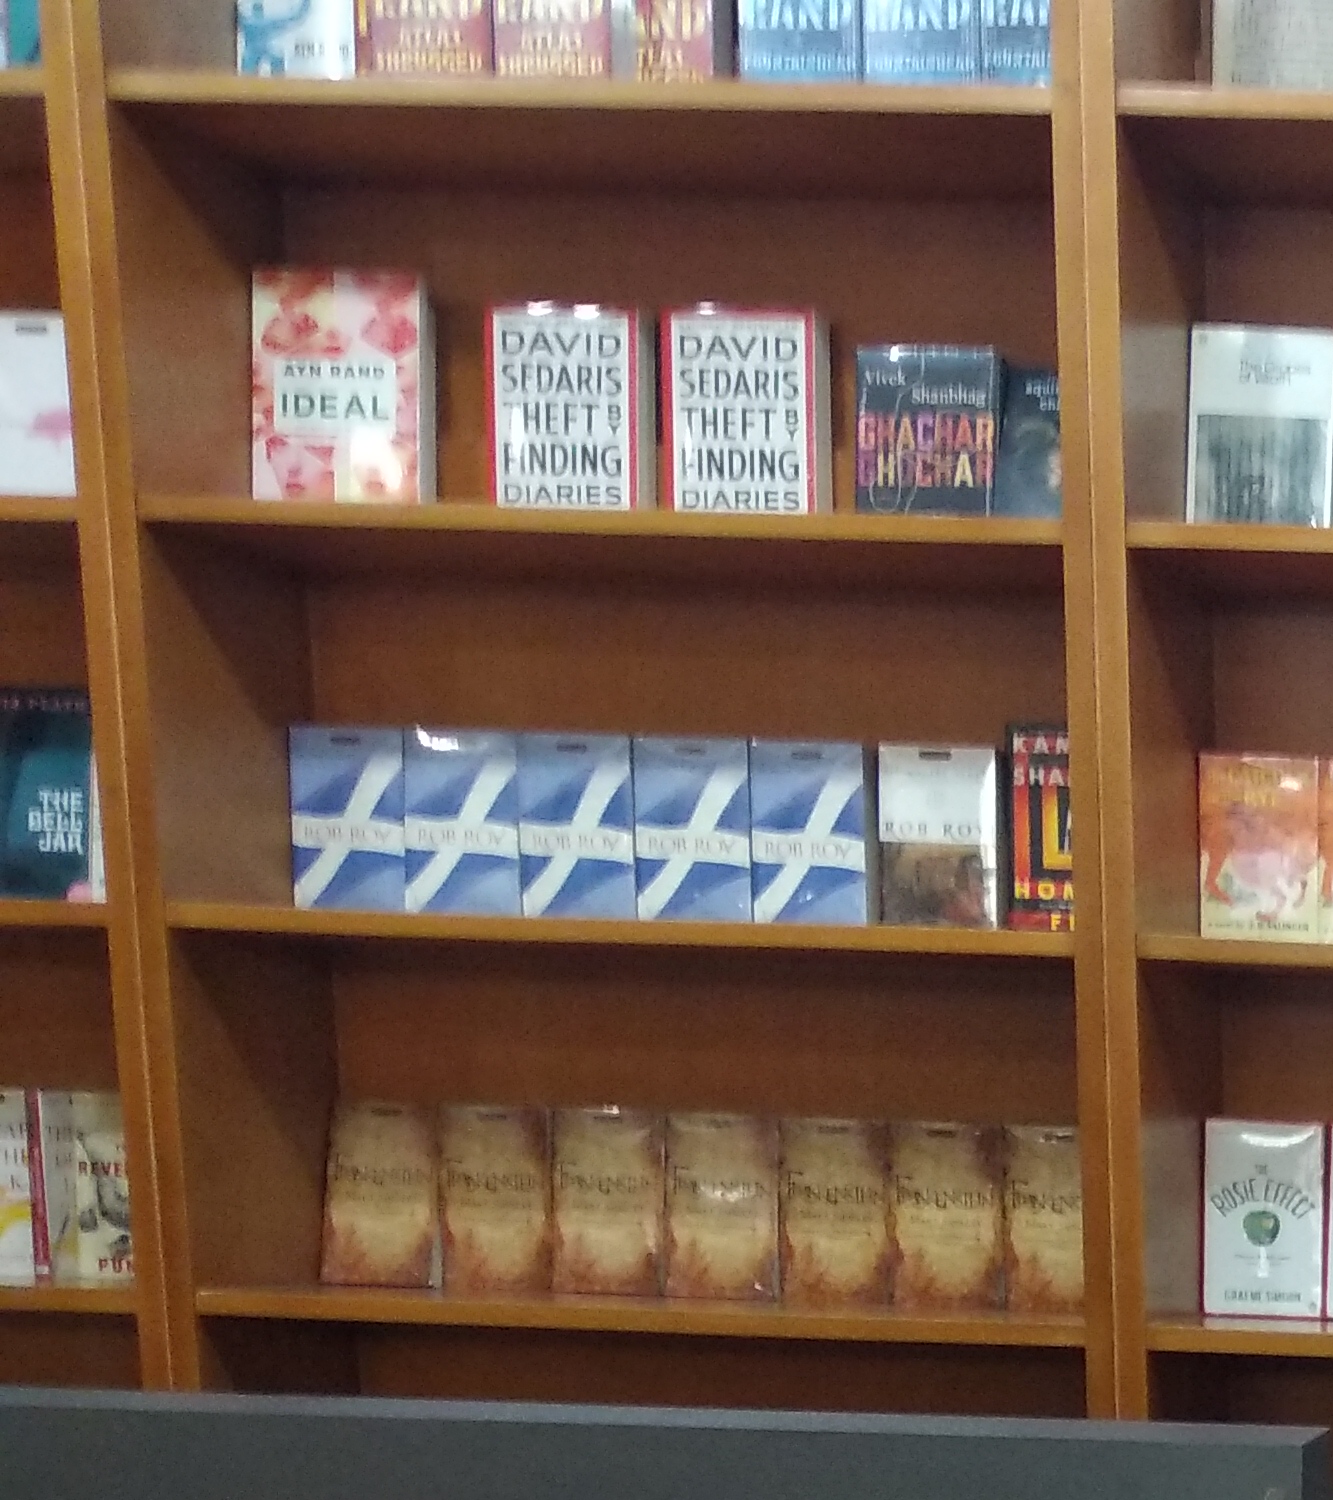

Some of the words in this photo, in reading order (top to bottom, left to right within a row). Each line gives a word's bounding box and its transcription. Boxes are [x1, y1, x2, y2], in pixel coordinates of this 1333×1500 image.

[501, 330, 622, 357] DAVID
[679, 334, 798, 363] DAVID
[502, 365, 622, 396] SEDARIS
[679, 369, 799, 401] SEDARIS
[279, 392, 390, 421] IDEAL
[508, 403, 601, 437] THEFT
[685, 407, 777, 441] THEFT
[503, 442, 622, 477] FINDING
[681, 449, 801, 483] FINDING
[502, 484, 622, 507] DIARIES
[681, 487, 801, 512] DIARIES
[39, 788, 85, 812] THE
[304, 825, 345, 843] ROB
[418, 828, 458, 844] ROB
[532, 834, 573, 851] ROB
[883, 821, 926, 838] ROB
[647, 836, 688, 855] ROB
[764, 841, 806, 858] ROB
[1210, 1177, 1257, 1218] ROSIE
[1263, 1178, 1317, 1220] EFFECT
